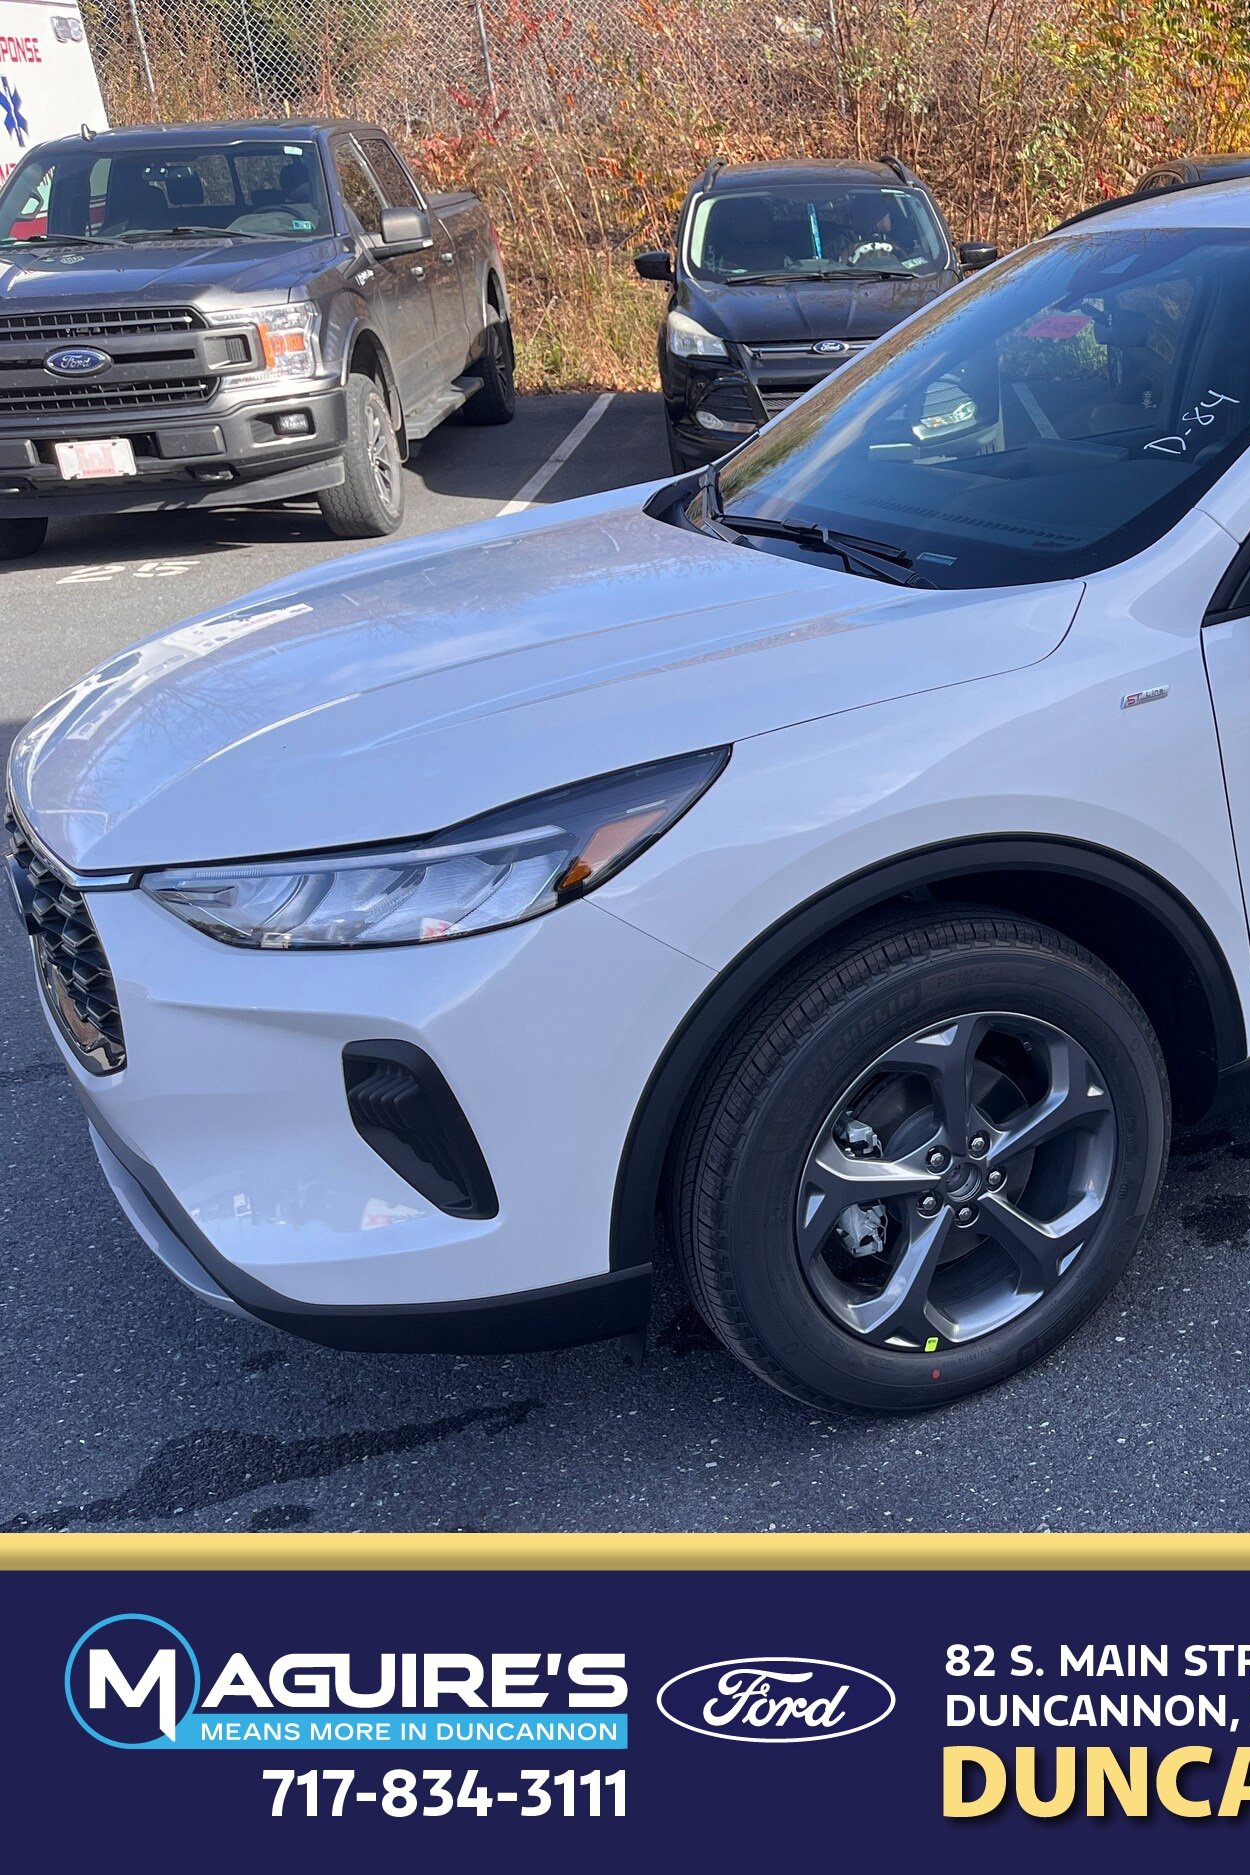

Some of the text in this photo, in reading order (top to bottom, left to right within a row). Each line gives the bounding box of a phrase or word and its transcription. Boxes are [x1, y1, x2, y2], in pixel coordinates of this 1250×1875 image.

[0, 36, 42, 63] PONSE
[820, 341, 841, 352] Ford
[60, 354, 91, 369] Ford
[1143, 389, 1240, 454] D-84
[1126, 693, 1143, 705] ST
[937, 966, 1006, 989] PRIMACY
